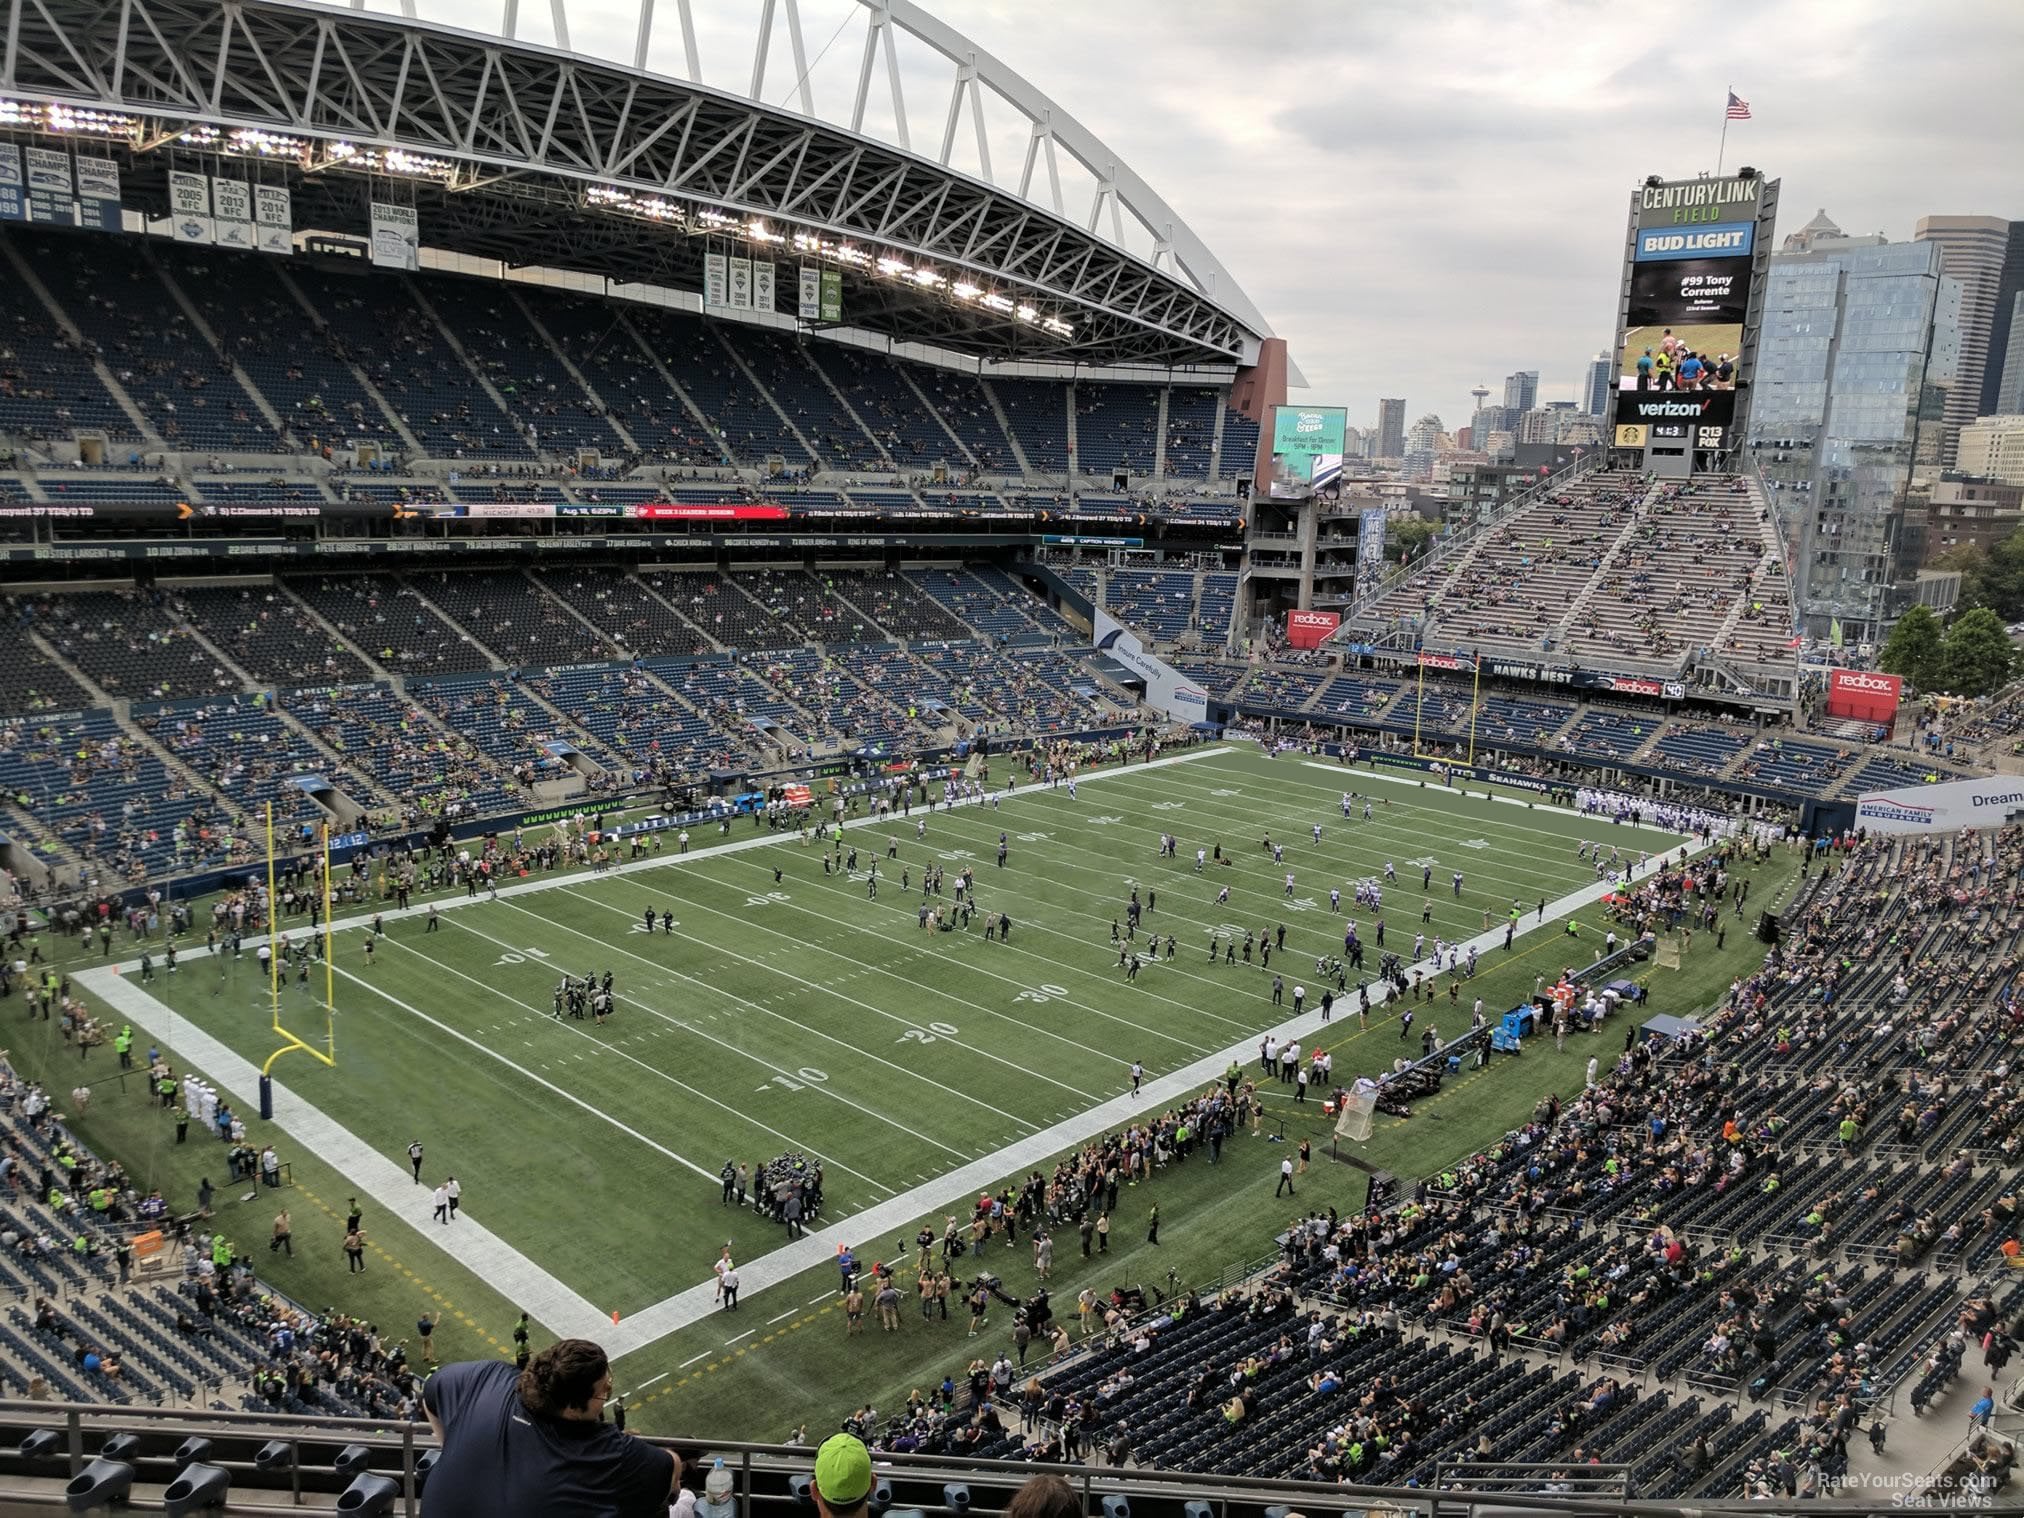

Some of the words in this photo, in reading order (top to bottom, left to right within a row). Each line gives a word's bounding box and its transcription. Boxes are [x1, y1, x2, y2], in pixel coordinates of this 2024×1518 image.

[45, 152, 68, 163] WEST
[28, 158, 70, 173] CHAMPS
[79, 166, 118, 180] CHAMPS
[177, 189, 202, 201] 2005
[220, 195, 245, 208] 2013
[1643, 180, 1757, 210] CENTURYLINK
[181, 200, 200, 210] NFC
[261, 202, 285, 214] 2014
[223, 207, 241, 217] NFC
[265, 213, 283, 223] NFC
[392, 207, 416, 218] WORLD
[1674, 207, 1719, 224] FIELD
[373, 213, 416, 226] CHAMPIONS
[1645, 235, 1684, 252] BUD
[1686, 231, 1744, 250] LIGHT
[1681, 276, 1703, 286] #99
[1706, 275, 1734, 287] Tony
[1681, 286, 1730, 297] Corrente
[1638, 400, 1702, 416] verizon
[1698, 426, 1723, 438] Q13
[1698, 437, 1720, 448] FOX
[32, 507, 46, 515] 37
[79, 507, 94, 515] TD
[228, 545, 241, 555] 22
[1117, 643, 1136, 662] Insure
[1136, 656, 1162, 680] Carefully
[551, 664, 575, 673] DELTA
[1494, 664, 1537, 680] HAWKS
[1541, 669, 1573, 684] NEST
[304, 686, 335, 696] DELTA
[1667, 684, 1682, 697] 40
[1488, 773, 1547, 791] SEAHAWKS
[1972, 792, 2024, 807] Dream
[1861, 804, 1902, 815] AMERICAN
[1903, 807, 1933, 818] FAMILY
[1865, 811, 1927, 823] INSURANCE
[352, 834, 363, 846] 12
[747, 891, 791, 905] 30
[500, 947, 550, 964] 10
[1020, 984, 1069, 1003] 30
[904, 1022, 959, 1044] 20
[771, 1067, 829, 1092] 10
